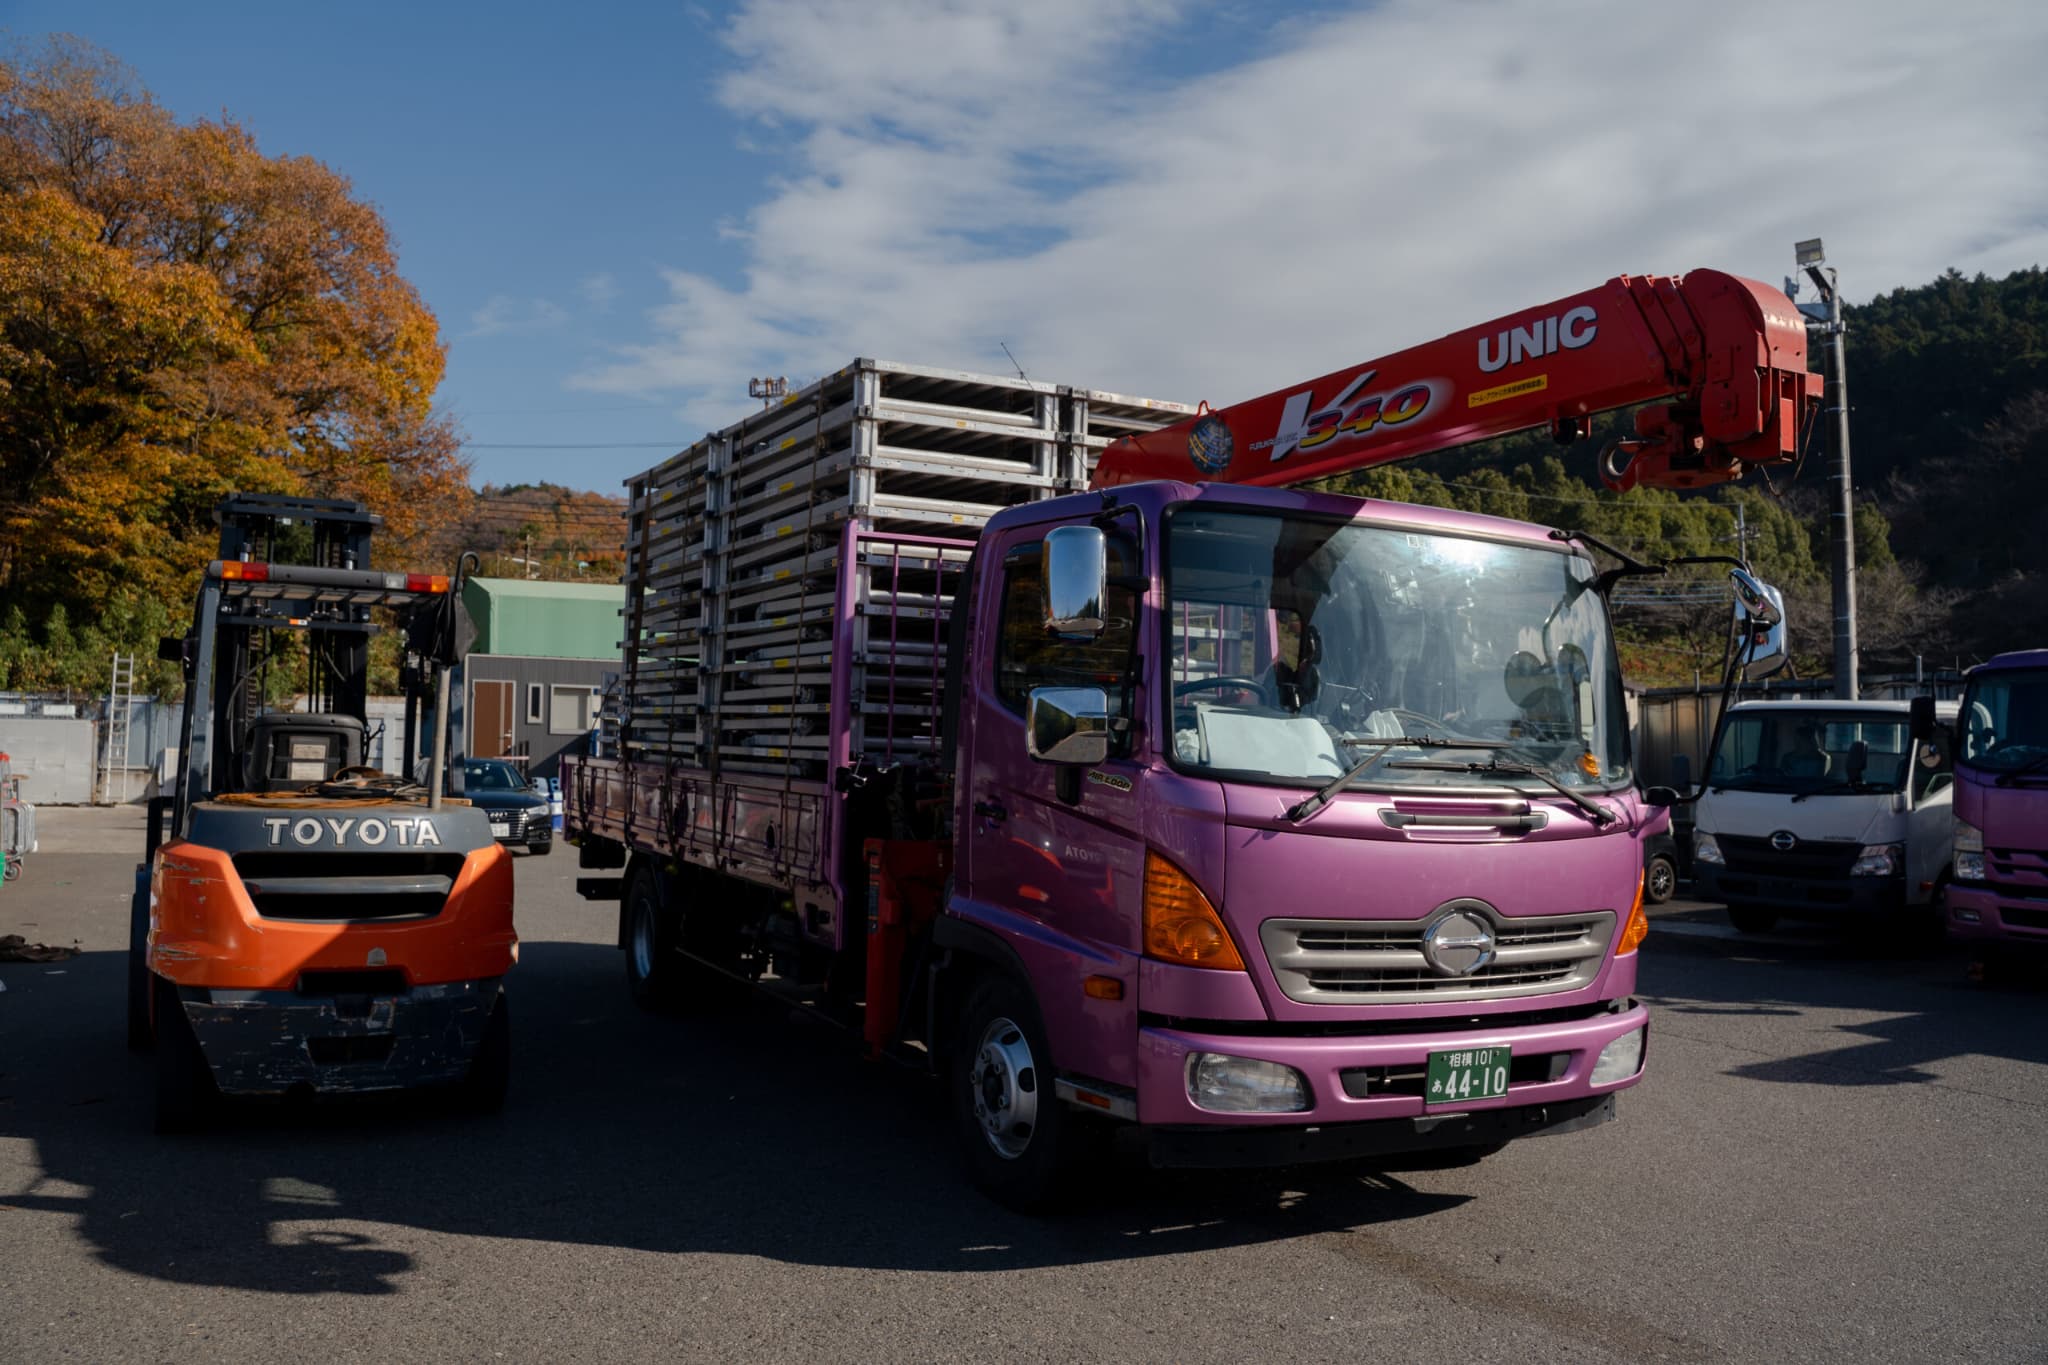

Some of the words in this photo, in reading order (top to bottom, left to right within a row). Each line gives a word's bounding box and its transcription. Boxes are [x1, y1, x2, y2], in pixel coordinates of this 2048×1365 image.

[1477, 305, 1599, 373] UNIC
[1105, 777, 1130, 789] LOOP
[264, 818, 442, 846] TOYOTA
[1475, 1049, 1492, 1065] 101
[1431, 1078, 1442, 1093] あ
[1445, 1066, 1506, 1098] 44-10
